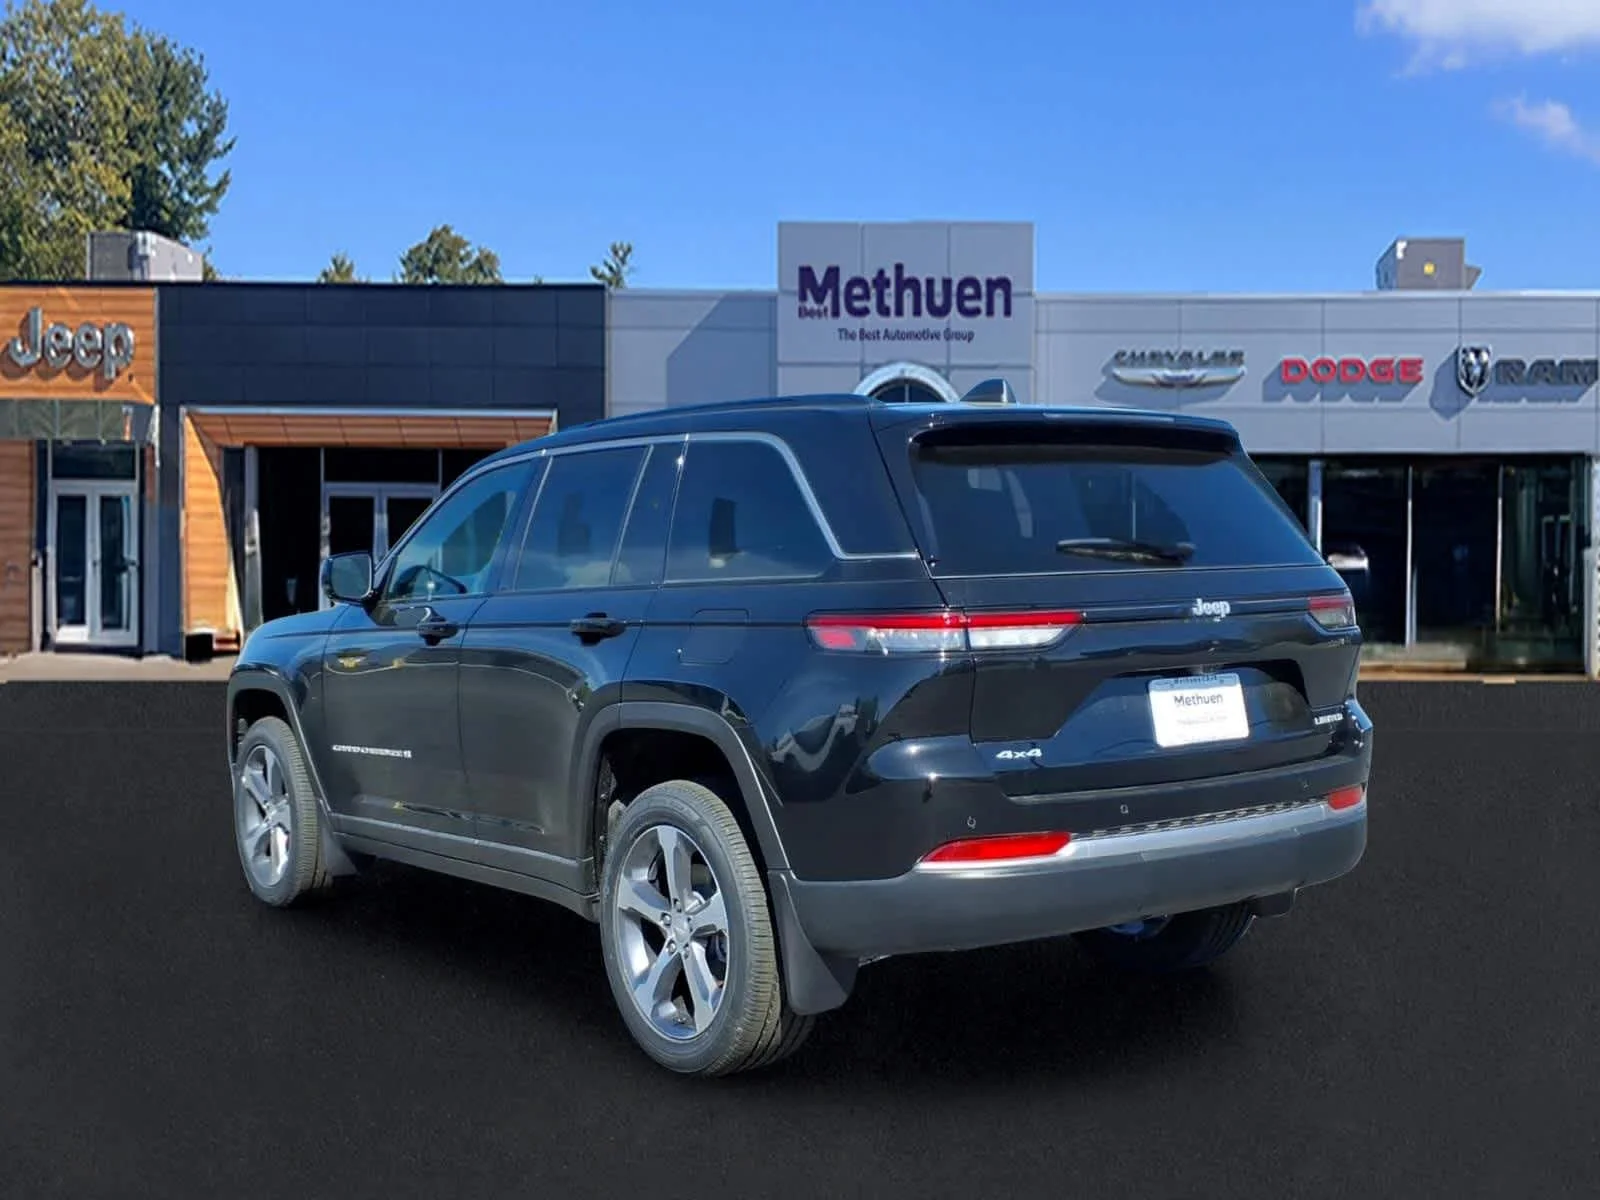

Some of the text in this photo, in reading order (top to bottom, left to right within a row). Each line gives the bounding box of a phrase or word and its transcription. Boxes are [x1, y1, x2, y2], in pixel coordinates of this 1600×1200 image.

[798, 263, 1012, 318] Methuen
[9, 306, 135, 379] Jeep
[838, 327, 975, 344] The Best Automotive Group
[1281, 358, 1424, 383] DODGE
[1495, 359, 1599, 385] RAM
[1191, 598, 1231, 618] Jeep
[1173, 693, 1225, 706] Methuen
[996, 748, 1042, 759] 4x4
